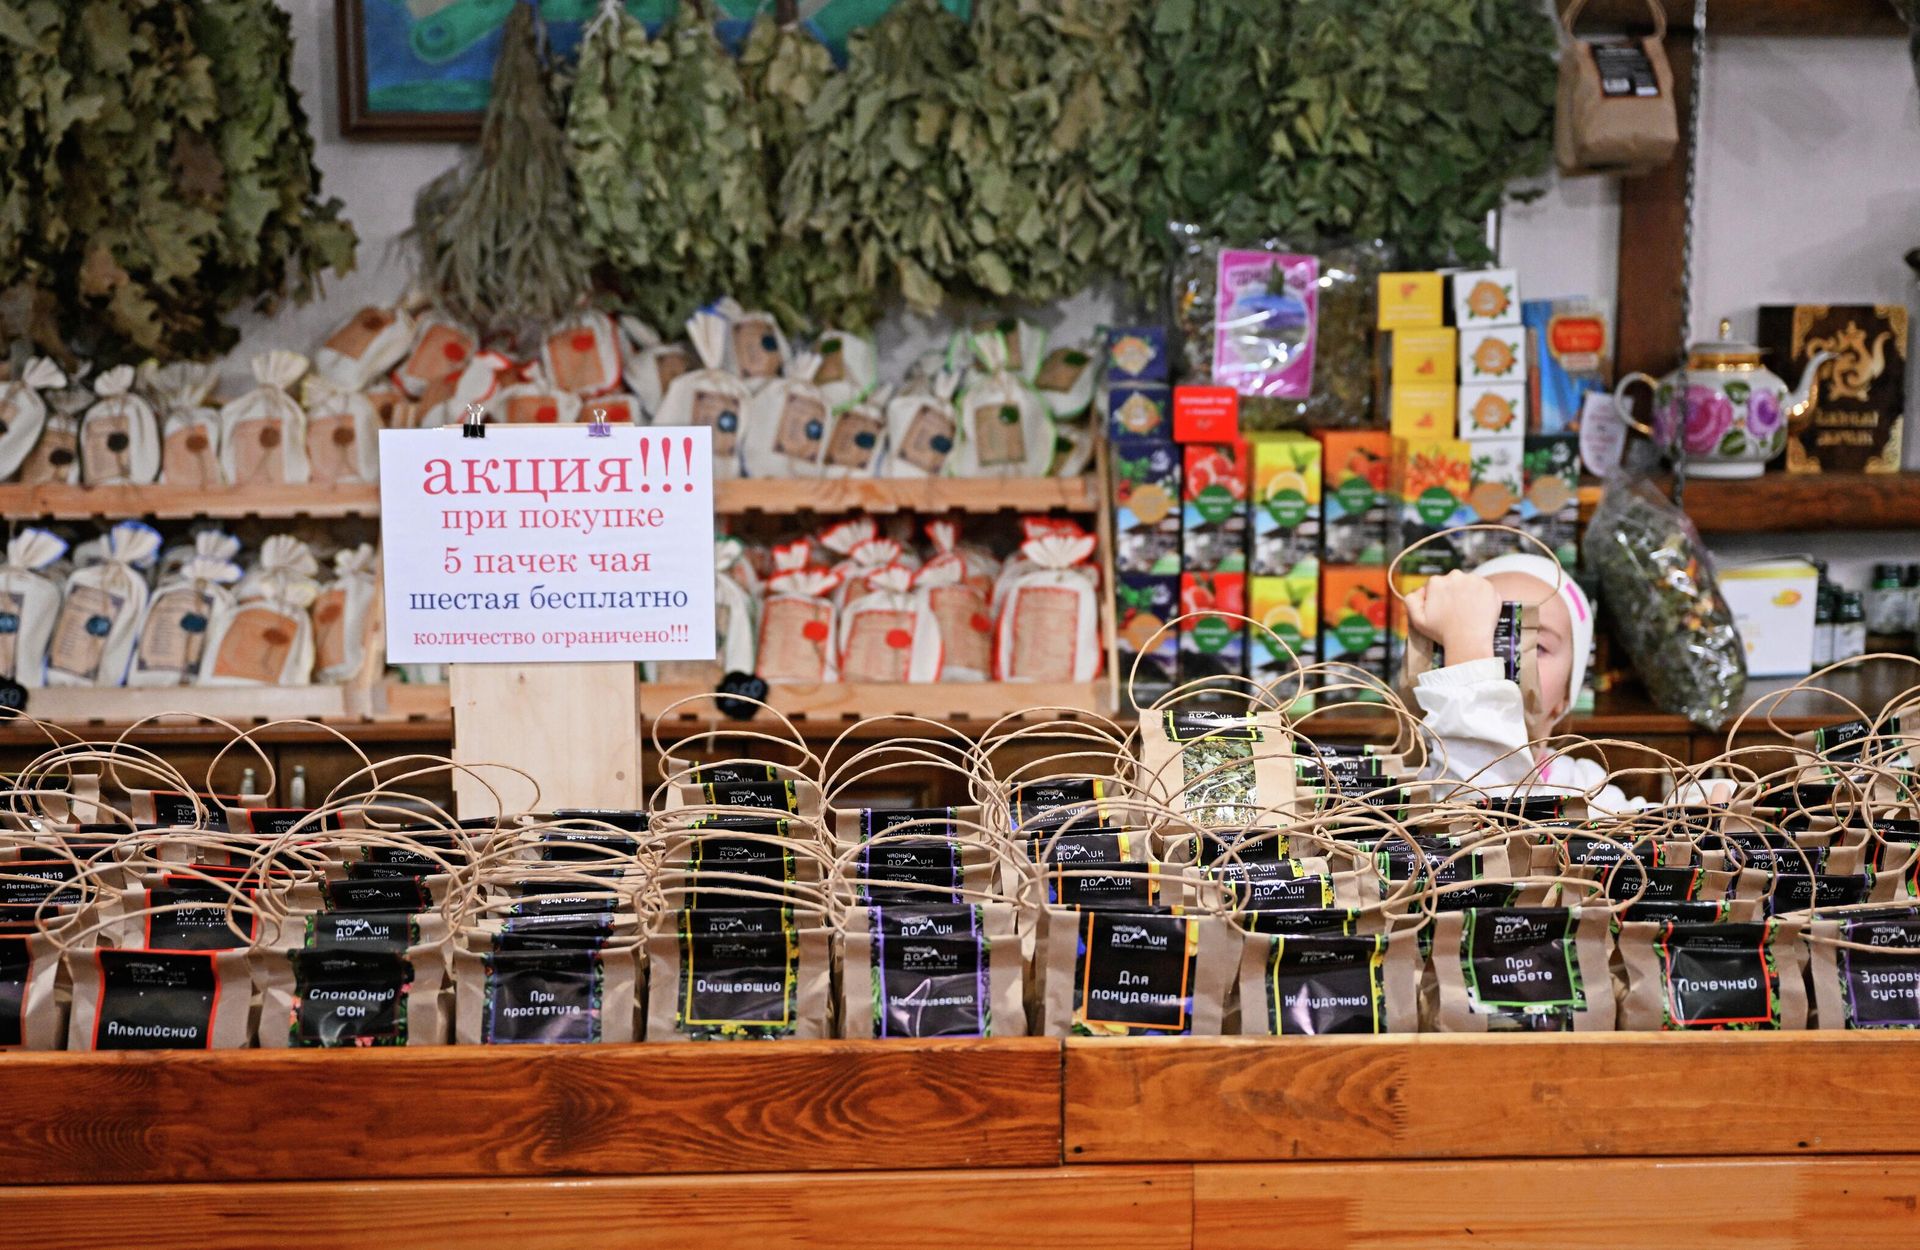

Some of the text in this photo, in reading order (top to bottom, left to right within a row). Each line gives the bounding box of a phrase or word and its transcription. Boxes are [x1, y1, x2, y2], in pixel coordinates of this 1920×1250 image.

[423, 436, 694, 503] акция!!!
[441, 507, 664, 536] при покупке
[444, 547, 651, 574] 5 пачек чая
[409, 584, 688, 610] шестая бесплатно
[413, 625, 689, 648] количество ограничено!!!
[1505, 956, 1533, 971] При
[1118, 970, 1150, 986] Для
[1491, 969, 1553, 985] диабете
[696, 979, 782, 994] Очищающий
[1678, 978, 1758, 993] Почечный
[309, 988, 395, 1001] Спокойный
[530, 990, 555, 1004] При
[1284, 994, 1369, 1010] Жлудочный
[503, 1005, 581, 1019] простатите
[107, 1021, 198, 1039] Альпийский
